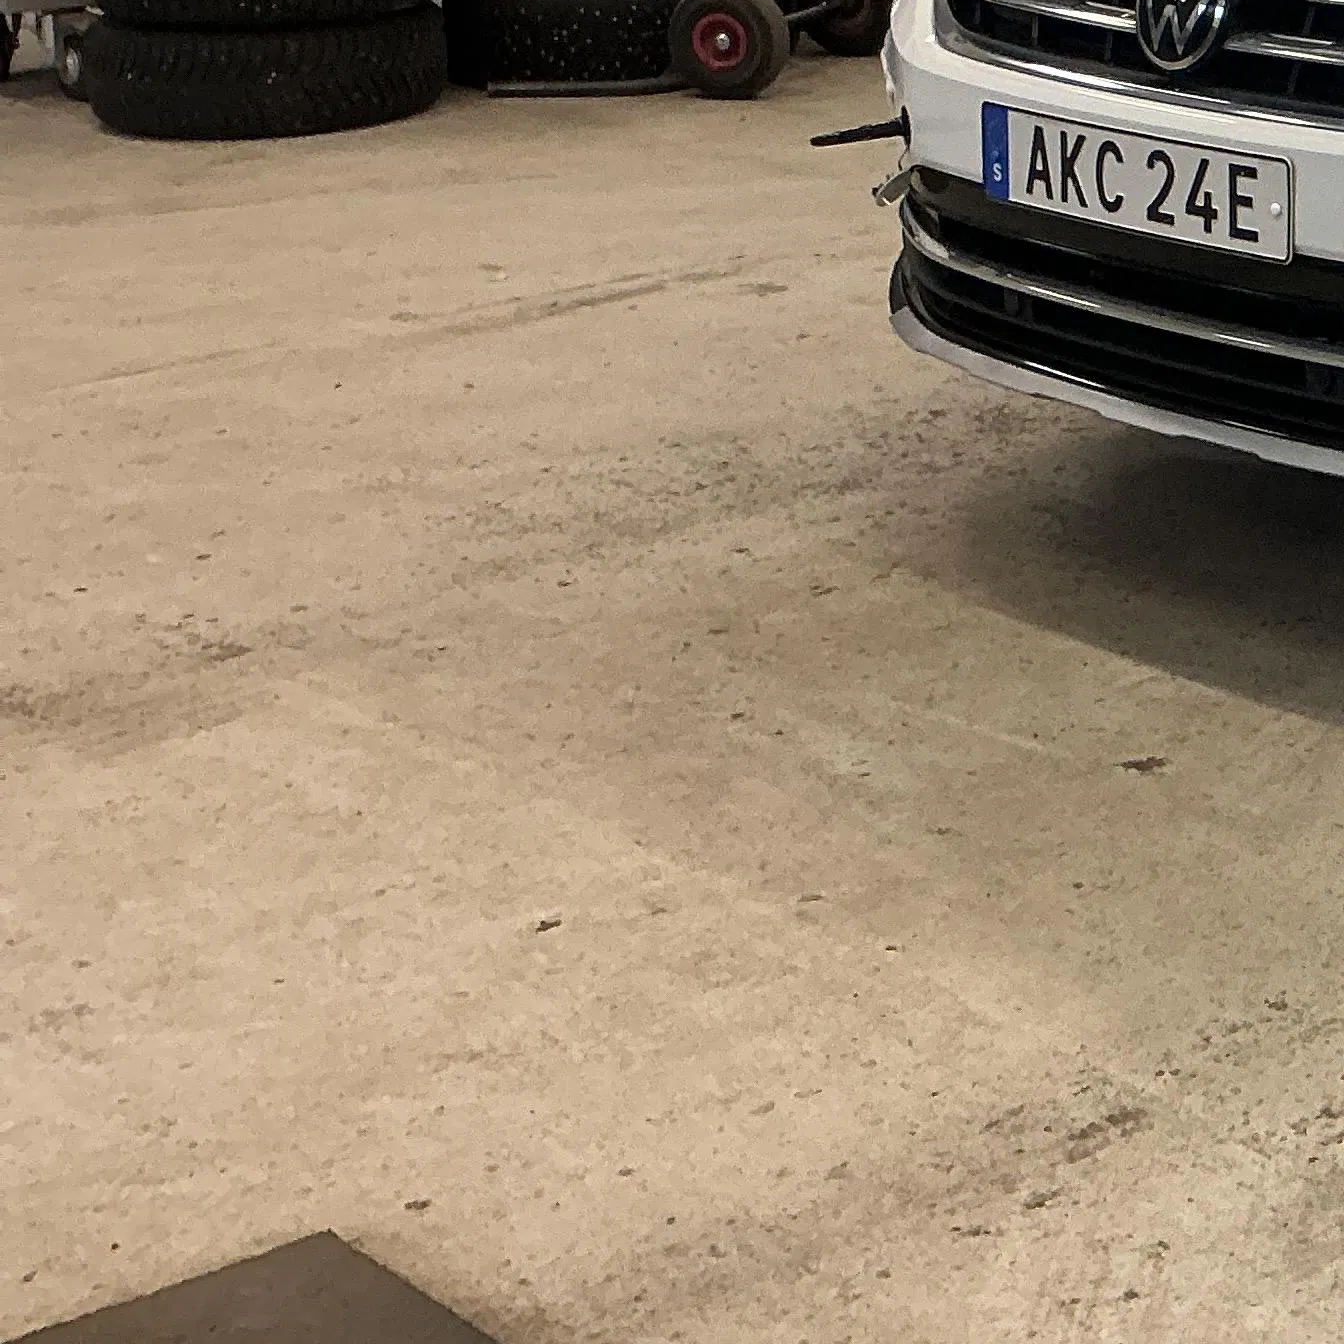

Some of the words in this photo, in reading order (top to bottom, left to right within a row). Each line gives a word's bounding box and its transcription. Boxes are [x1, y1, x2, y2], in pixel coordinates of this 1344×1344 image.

[992, 163, 1003, 183] S
[1025, 124, 1125, 214] AKC
[1146, 149, 1260, 243] 24E
